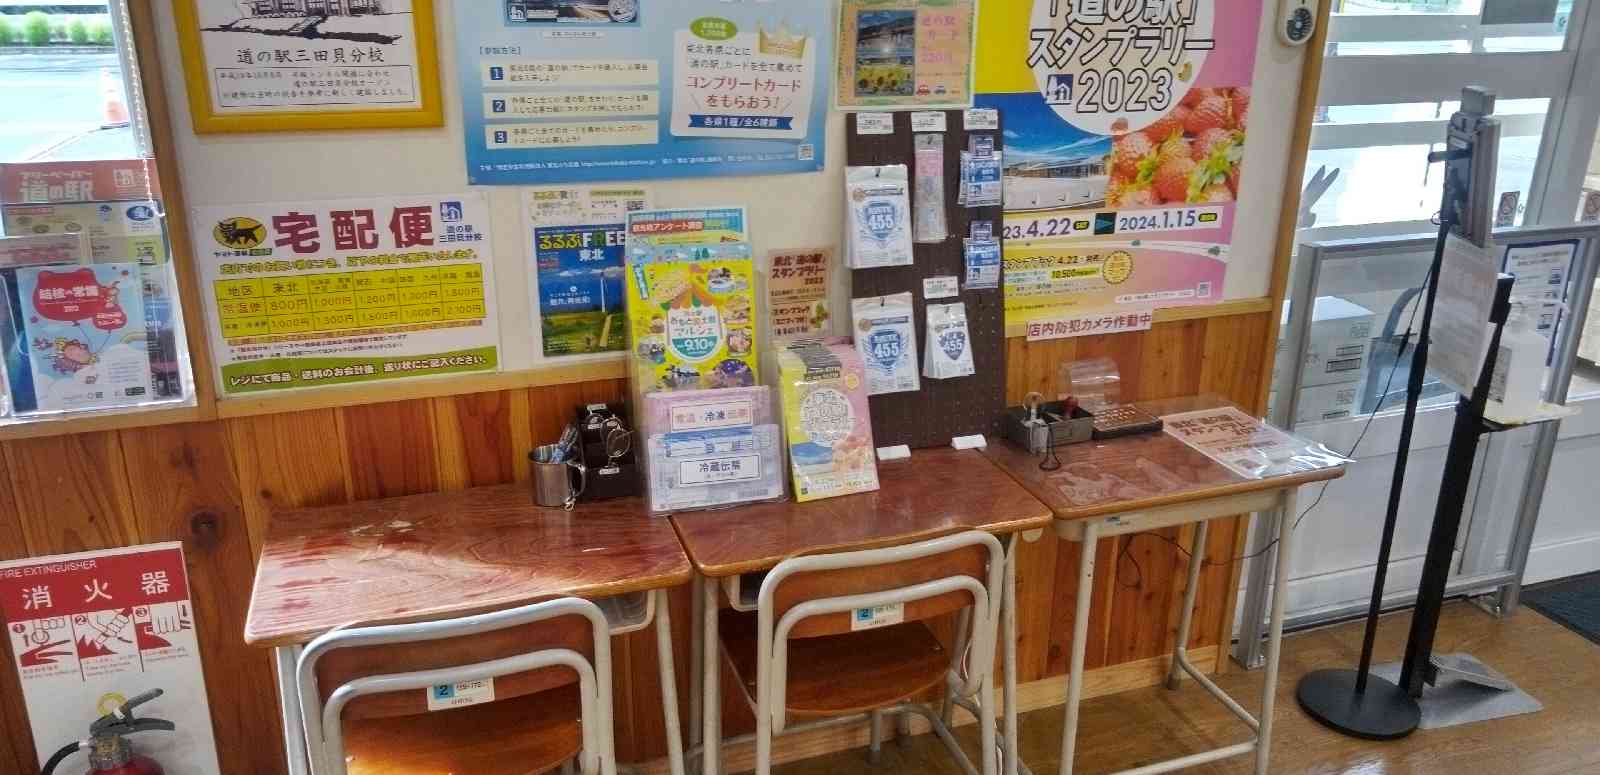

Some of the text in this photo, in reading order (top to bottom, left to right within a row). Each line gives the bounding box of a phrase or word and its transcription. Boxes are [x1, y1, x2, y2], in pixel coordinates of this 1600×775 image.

[1026, 25, 1216, 69] スタンプラリー
[237, 48, 385, 65] 道の駅三田貝分校
[494, 68, 501, 79] 1
[687, 76, 801, 93] コンプリートカード
[1076, 68, 1173, 113] 2023
[495, 101, 504, 112] 2
[497, 132, 506, 142] 3
[20, 179, 95, 203] 道の駅
[867, 214, 894, 231] 455
[1119, 209, 1196, 232] 2024.1.15
[272, 206, 434, 254] 宅配便
[579, 249, 605, 262] 東北
[771, 265, 826, 280] スタンプラリー
[271, 298, 308, 312] 800円
[1027, 311, 1152, 338] 店内防犯カメラ作動中
[874, 342, 900, 359] 455
[24, 559, 97, 577] EXTINGUISHER
[21, 570, 171, 610] 消火器
[439, 684, 449, 696] 2
